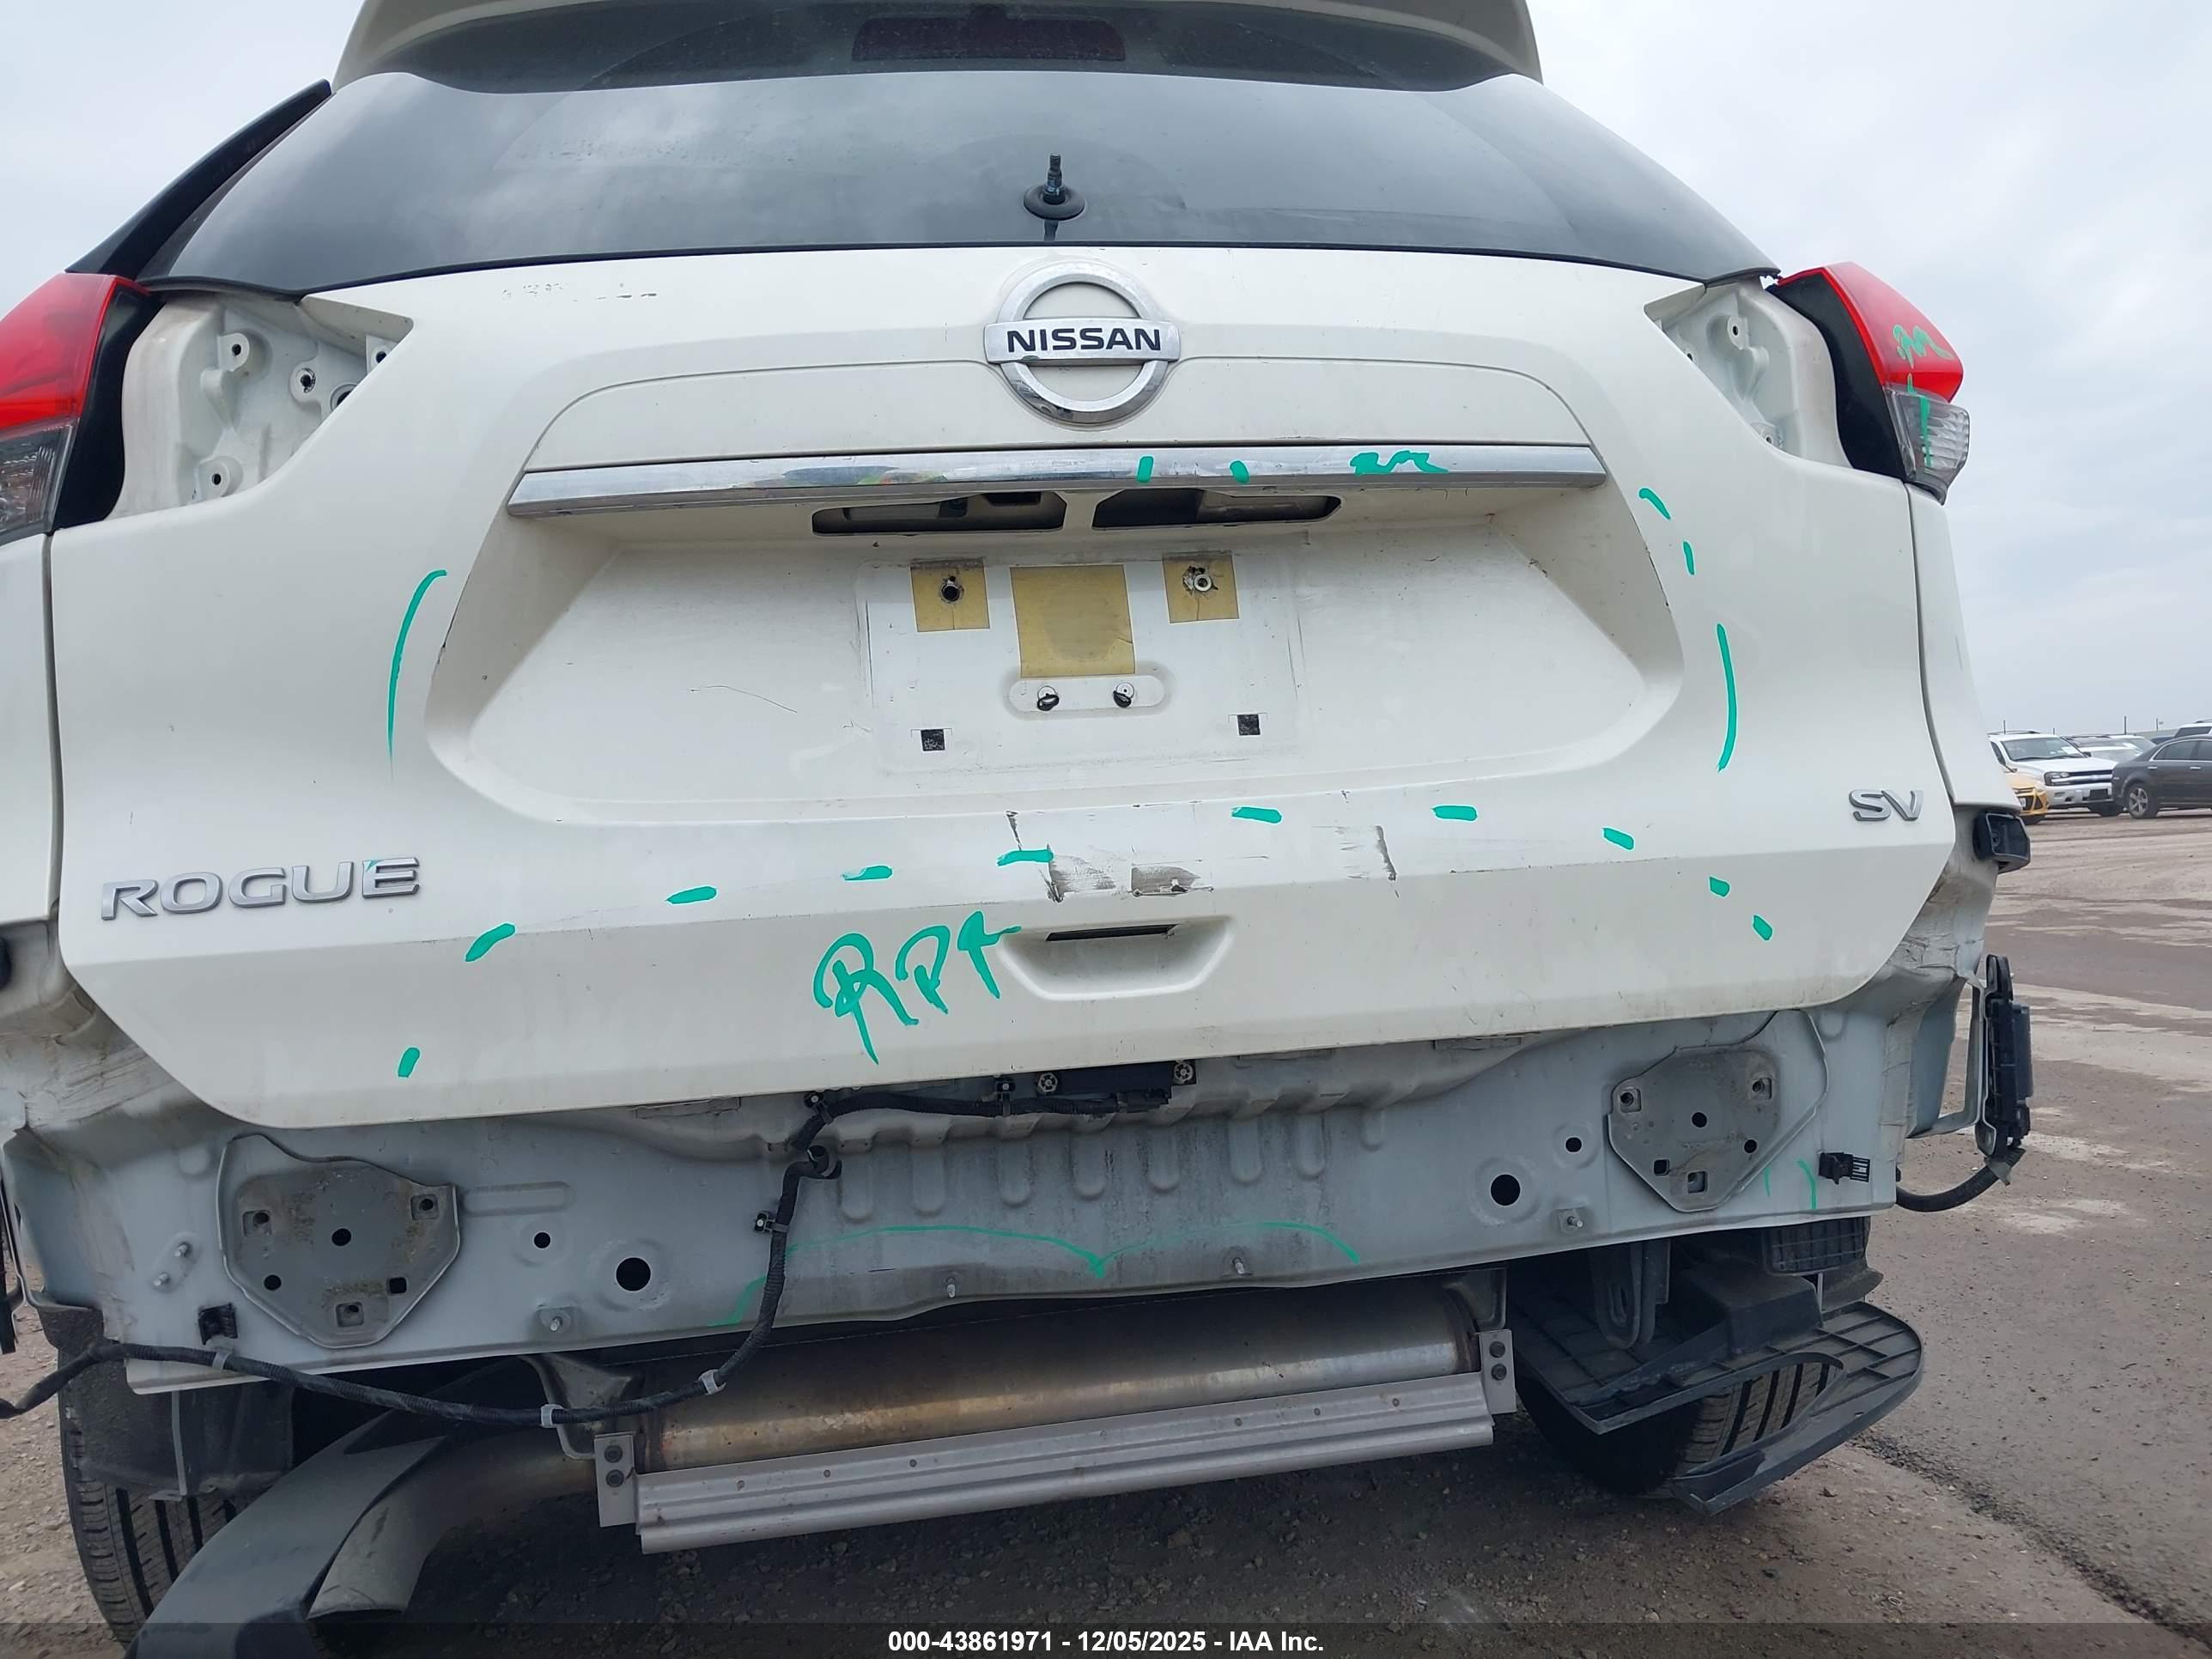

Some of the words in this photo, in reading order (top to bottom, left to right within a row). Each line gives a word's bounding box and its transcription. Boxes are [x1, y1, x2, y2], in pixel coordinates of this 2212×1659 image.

[1006, 327, 1162, 352] NISSAN
[1848, 789, 1923, 822] SV
[100, 856, 420, 921] ROGUE
